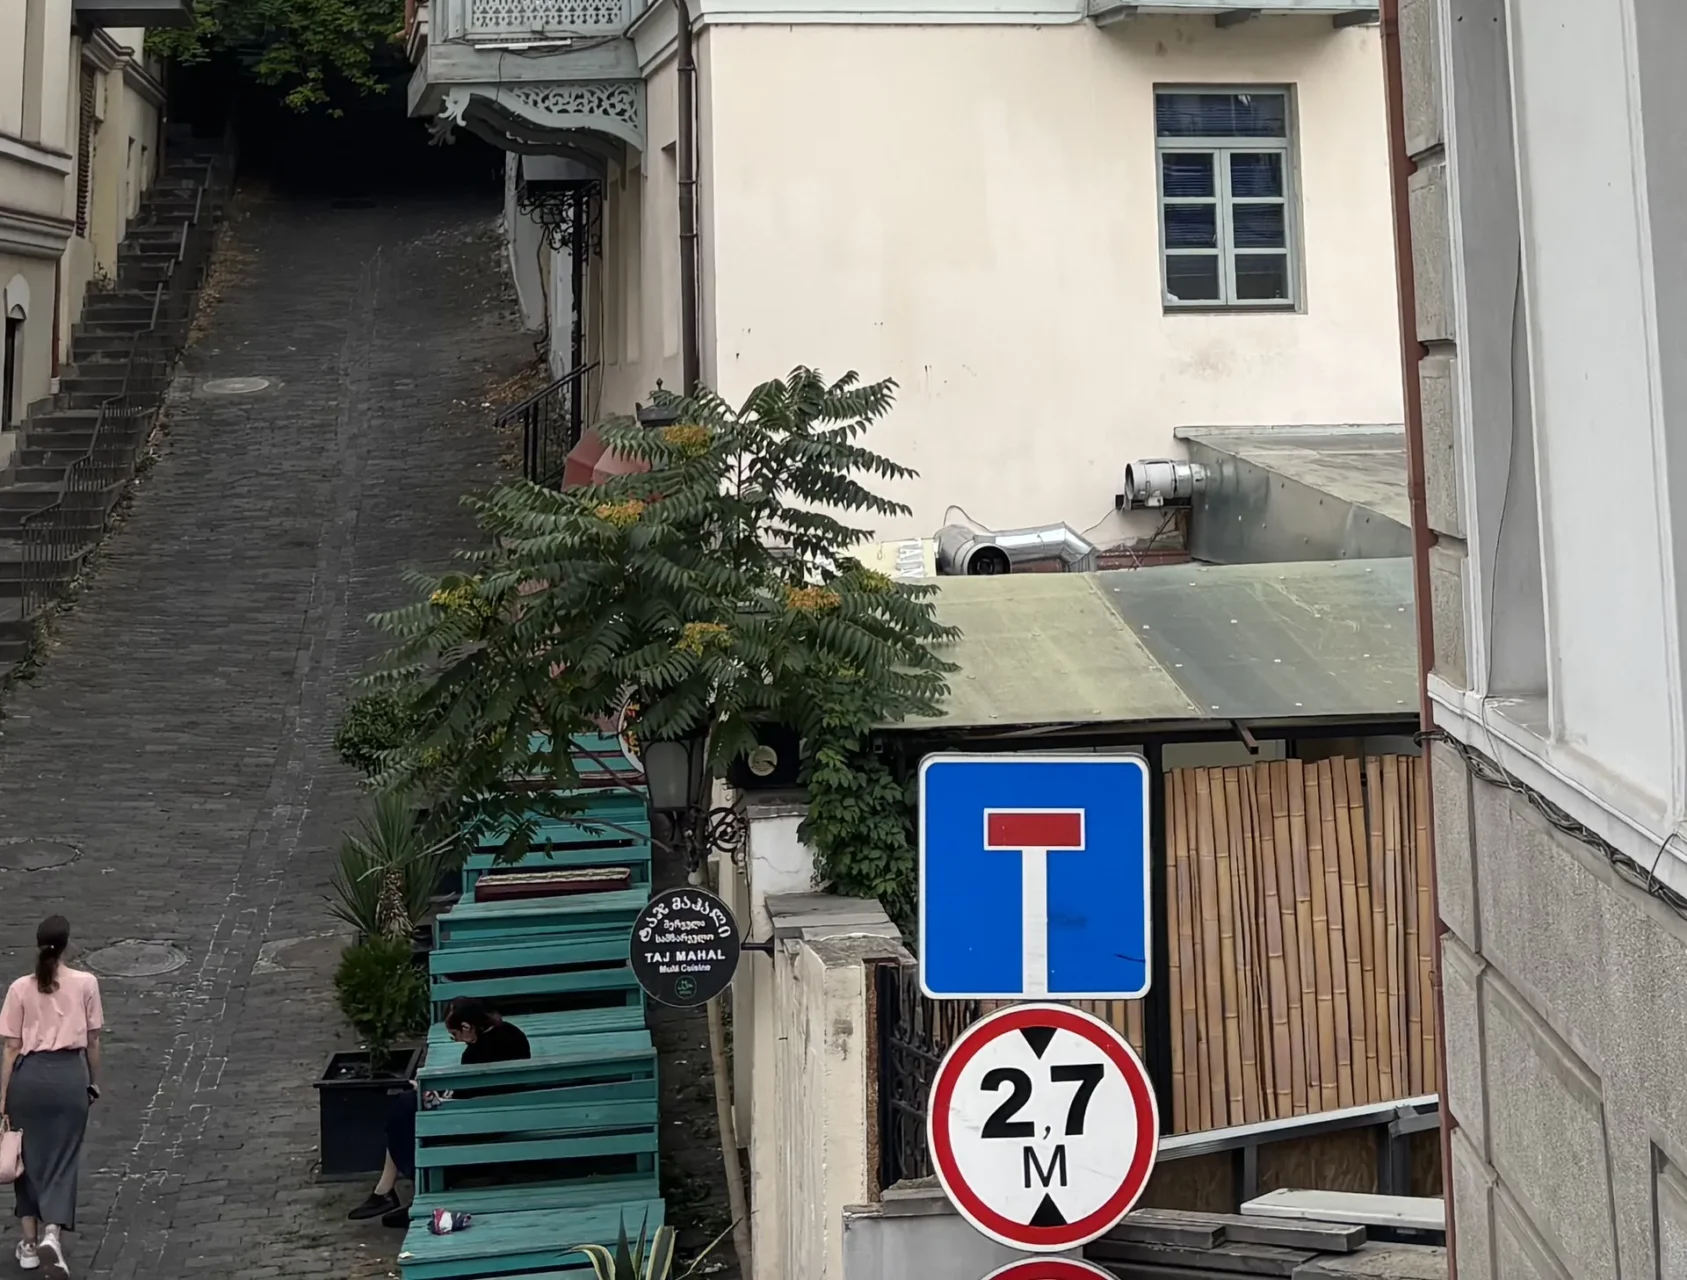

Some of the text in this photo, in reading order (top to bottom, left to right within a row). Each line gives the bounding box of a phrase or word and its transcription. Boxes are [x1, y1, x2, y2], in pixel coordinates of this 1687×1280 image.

[639, 896, 731, 943] ტაჯ მაჰალი
[645, 949, 726, 963] TAJ MAHAL
[681, 963, 711, 972] Cuisine
[980, 1063, 1104, 1140] 2,7
[1023, 1144, 1067, 1188] M
